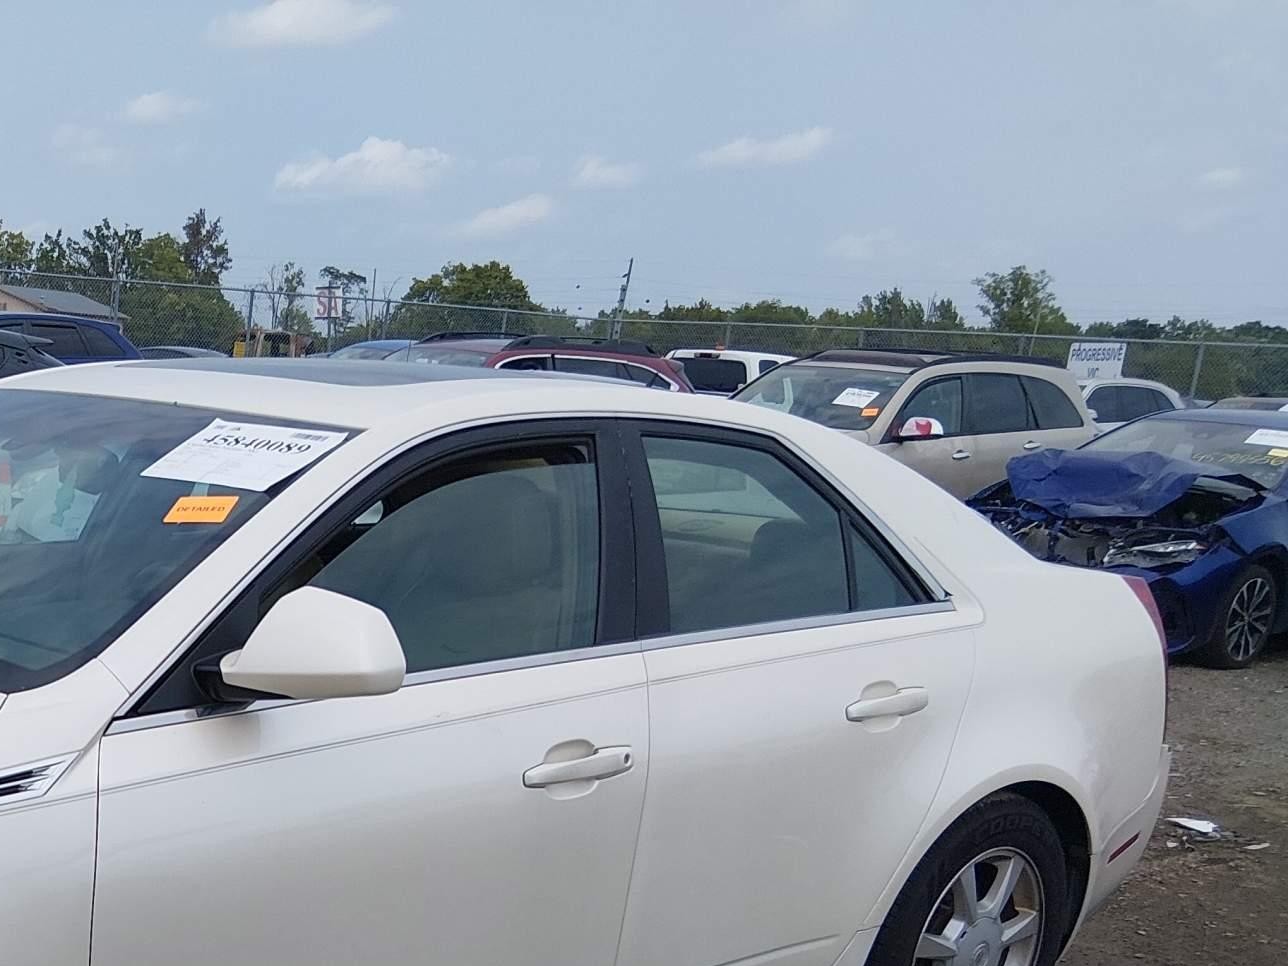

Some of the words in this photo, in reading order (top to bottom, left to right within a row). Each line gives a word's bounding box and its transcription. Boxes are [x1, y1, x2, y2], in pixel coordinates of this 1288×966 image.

[1071, 347, 1123, 361] PROGRESSIVE
[202, 432, 312, 455] 45840089
[176, 505, 226, 513] DETAILED
